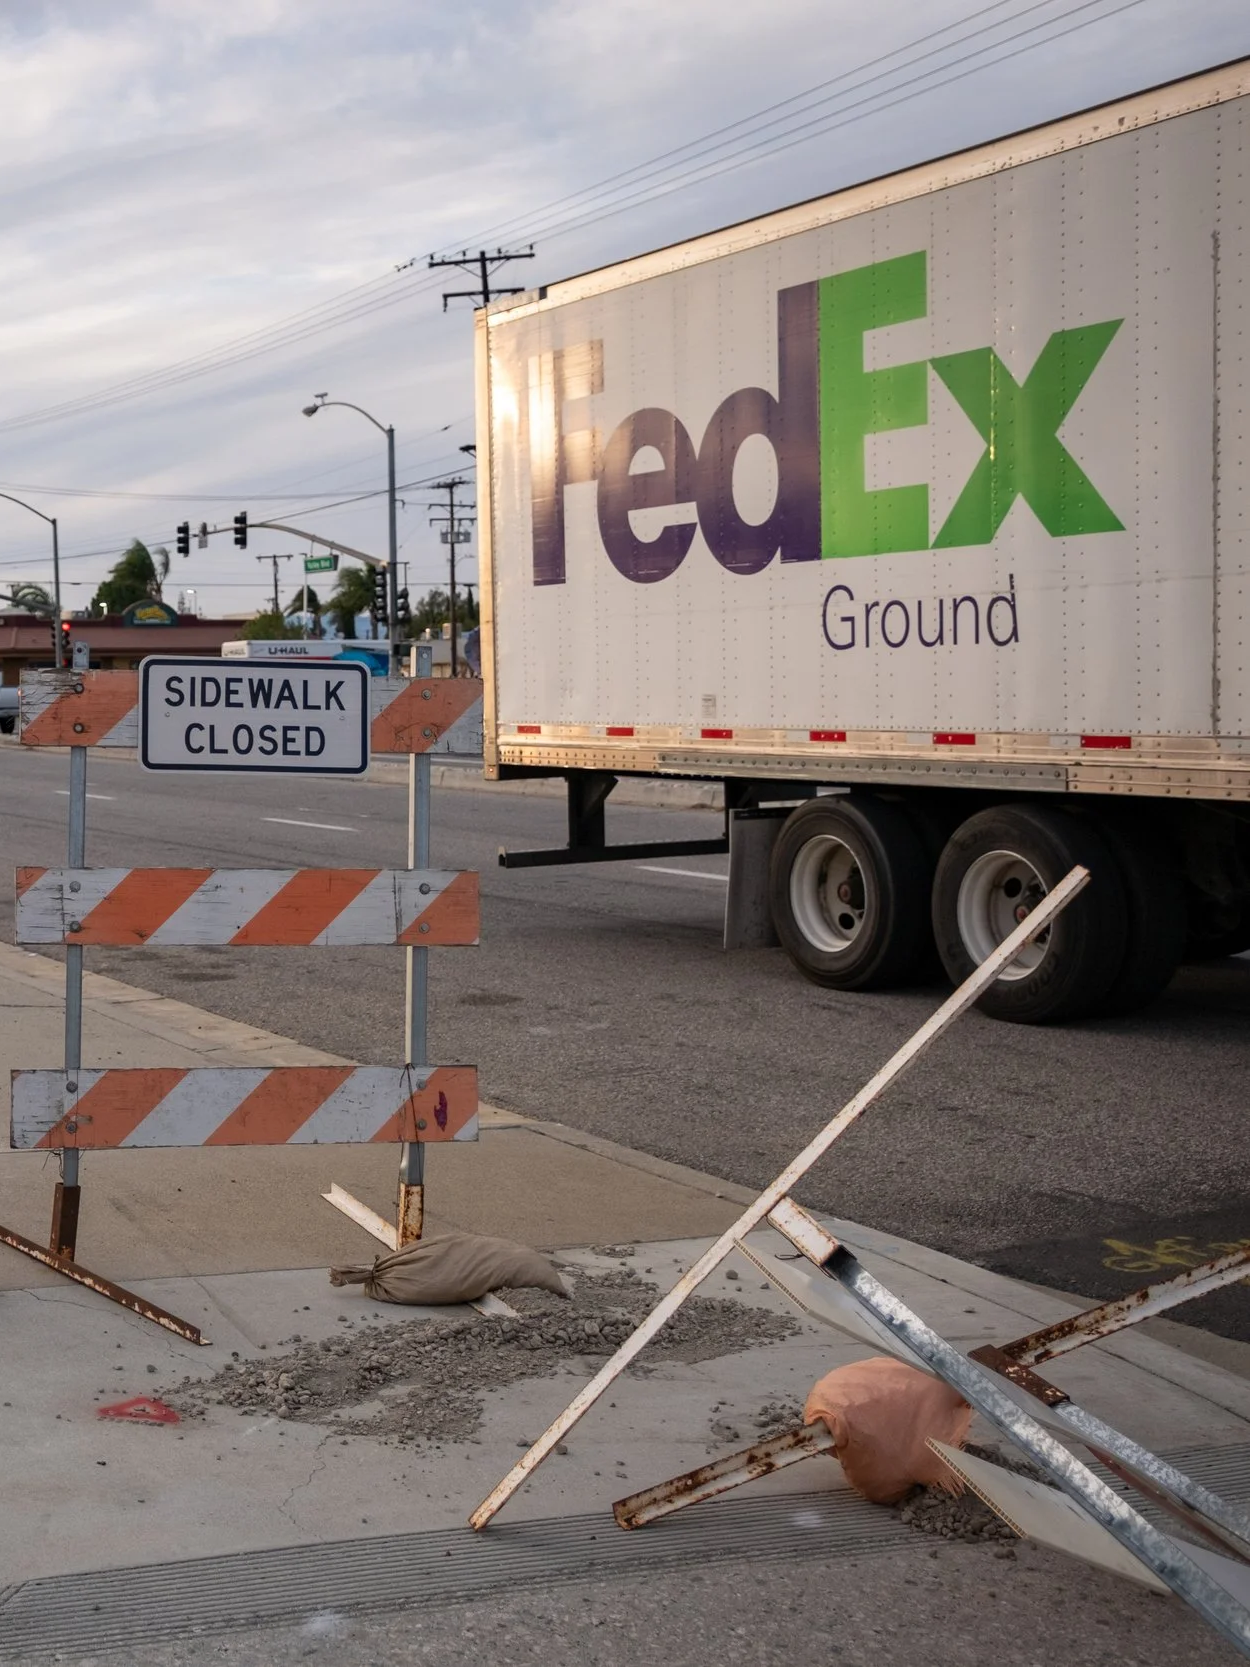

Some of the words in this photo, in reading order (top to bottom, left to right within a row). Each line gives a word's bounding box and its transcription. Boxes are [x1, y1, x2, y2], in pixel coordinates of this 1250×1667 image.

[528, 250, 1127, 587] FedEx
[822, 574, 1021, 651] Ground
[164, 676, 346, 711] SIDEWALK
[184, 723, 326, 757] CLOSED
